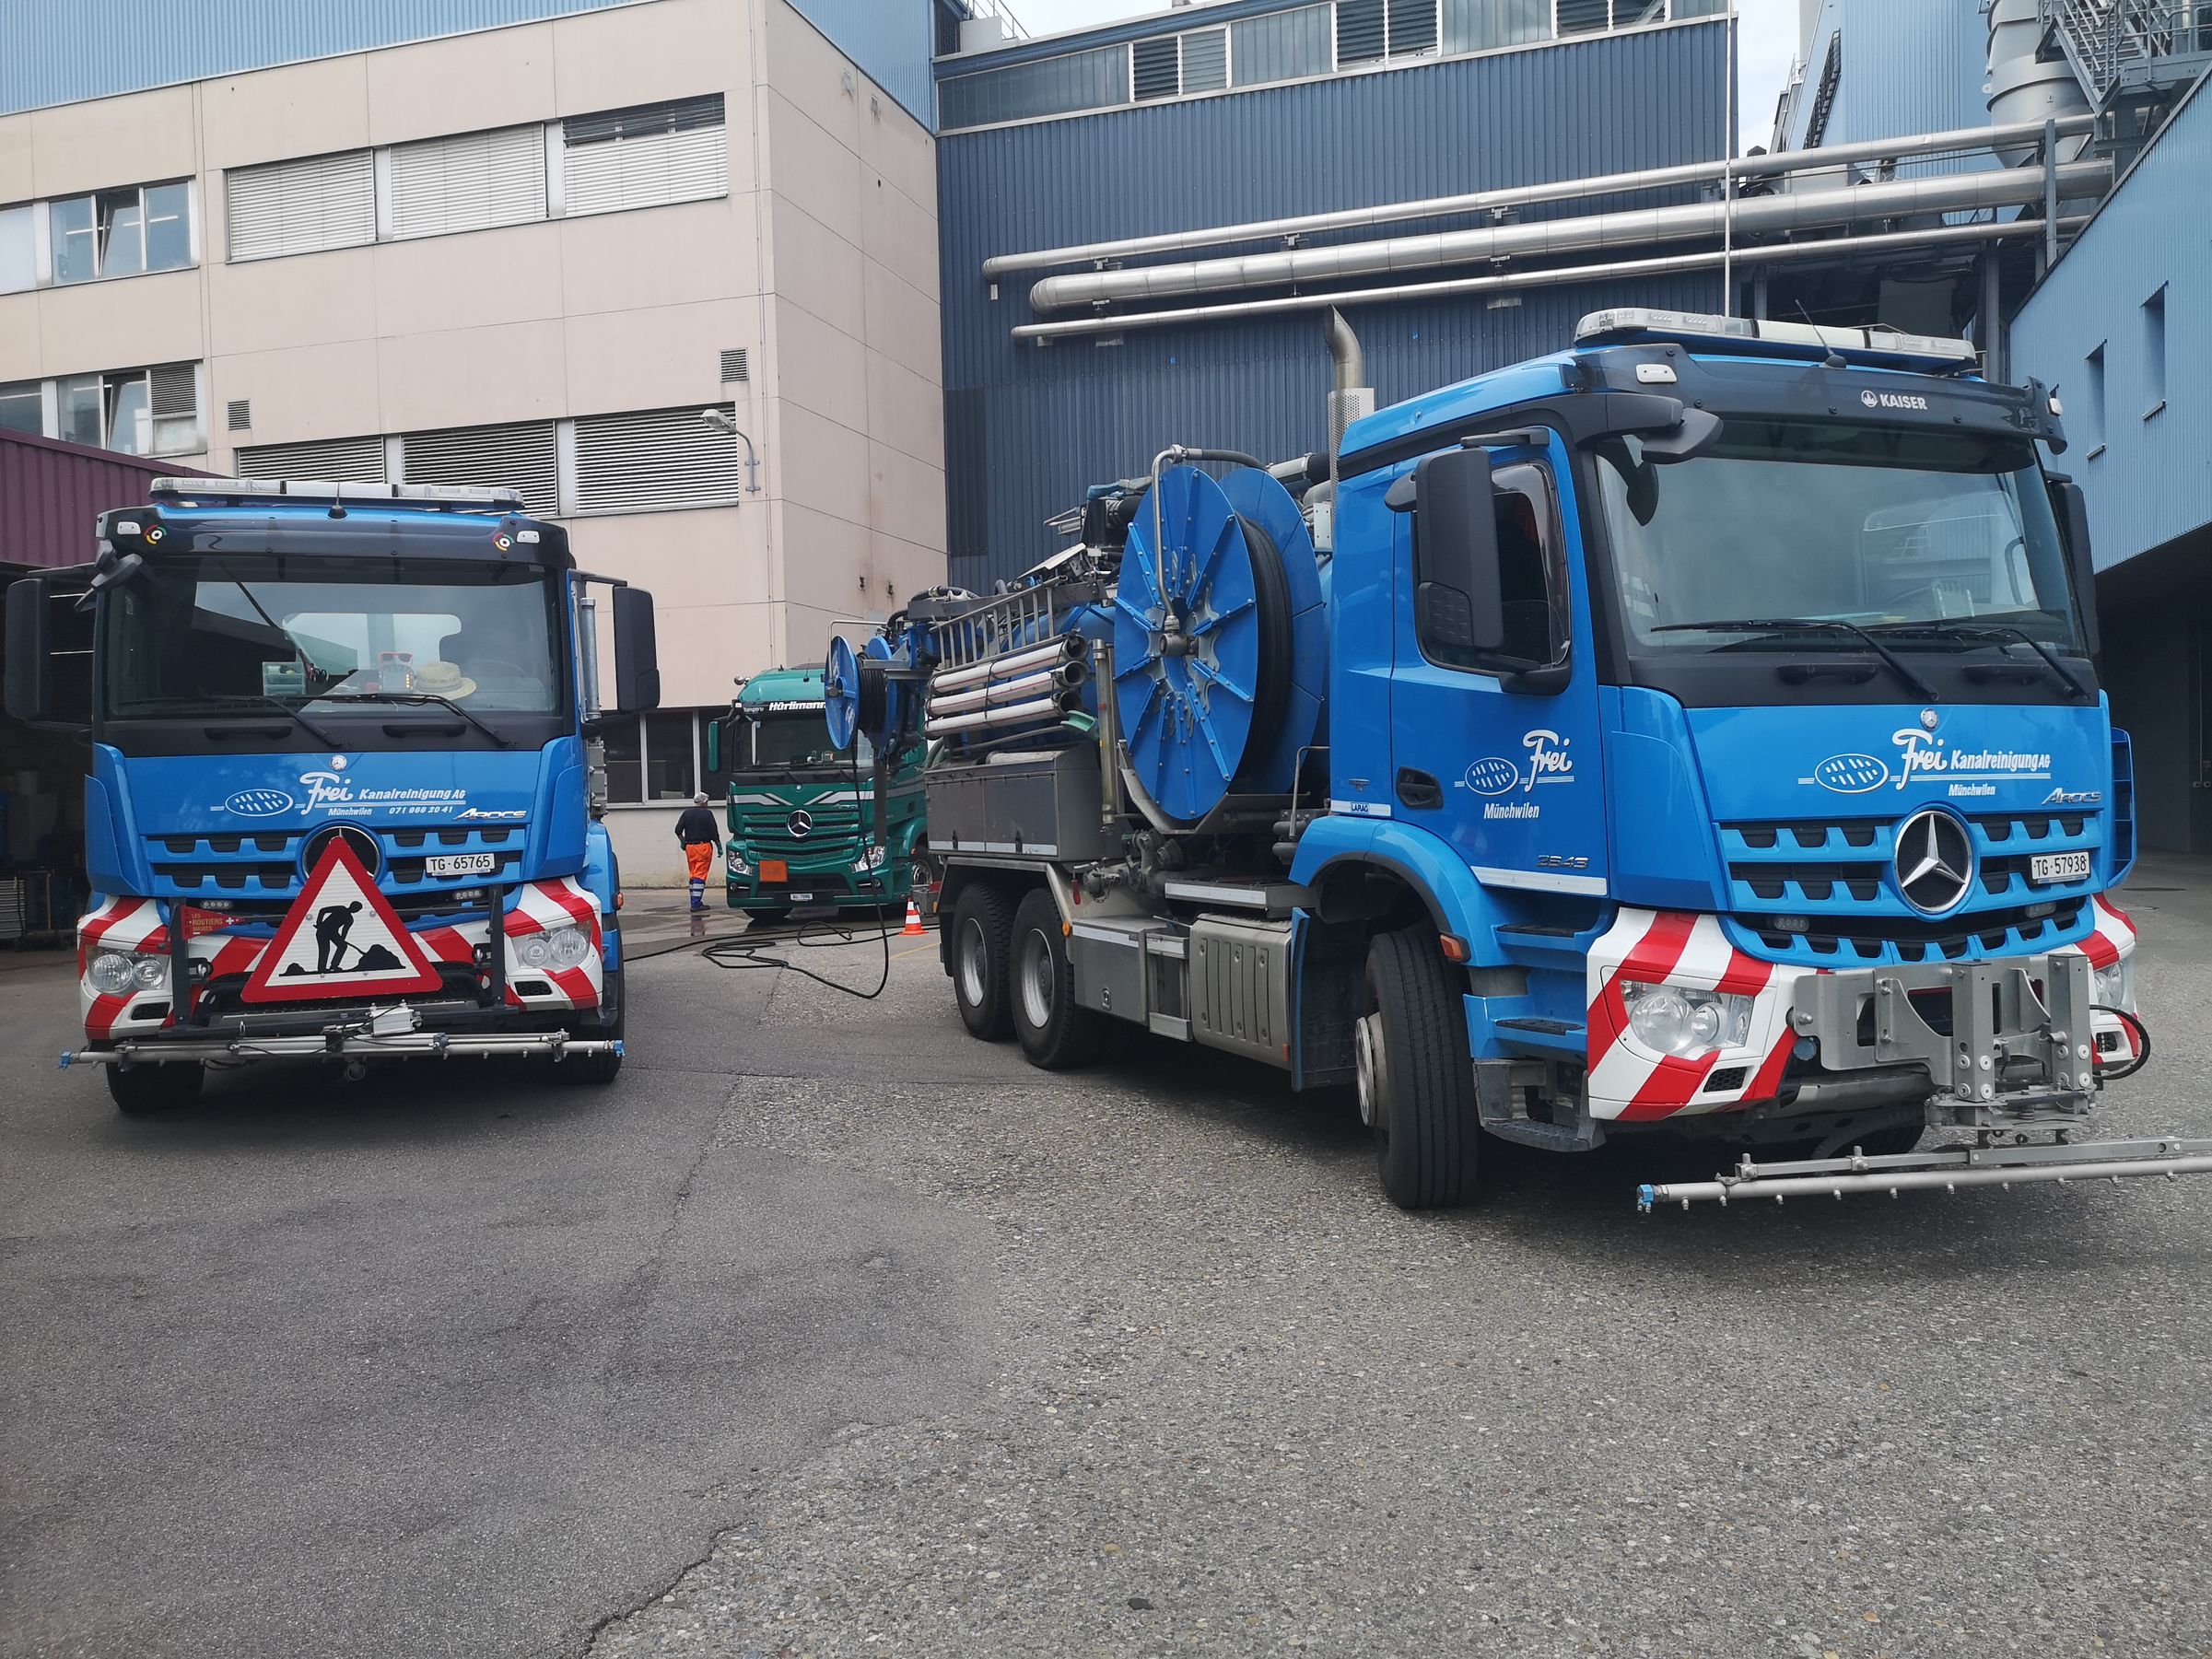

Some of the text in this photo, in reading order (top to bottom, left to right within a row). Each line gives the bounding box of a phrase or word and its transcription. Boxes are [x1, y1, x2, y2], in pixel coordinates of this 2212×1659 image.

[1879, 393, 1928, 410] KAISER
[1523, 729, 1573, 792] Frei
[1891, 728, 2051, 790] Frei Kanalreinigung AG
[299, 771, 466, 816] Frei Kanalreinigung AG
[1948, 783, 1996, 797] Münchwilen
[389, 806, 407, 815] 071
[427, 805, 441, 813] 20
[1351, 804, 1369, 812] LARAG
[1483, 802, 1540, 820] Münchwilen
